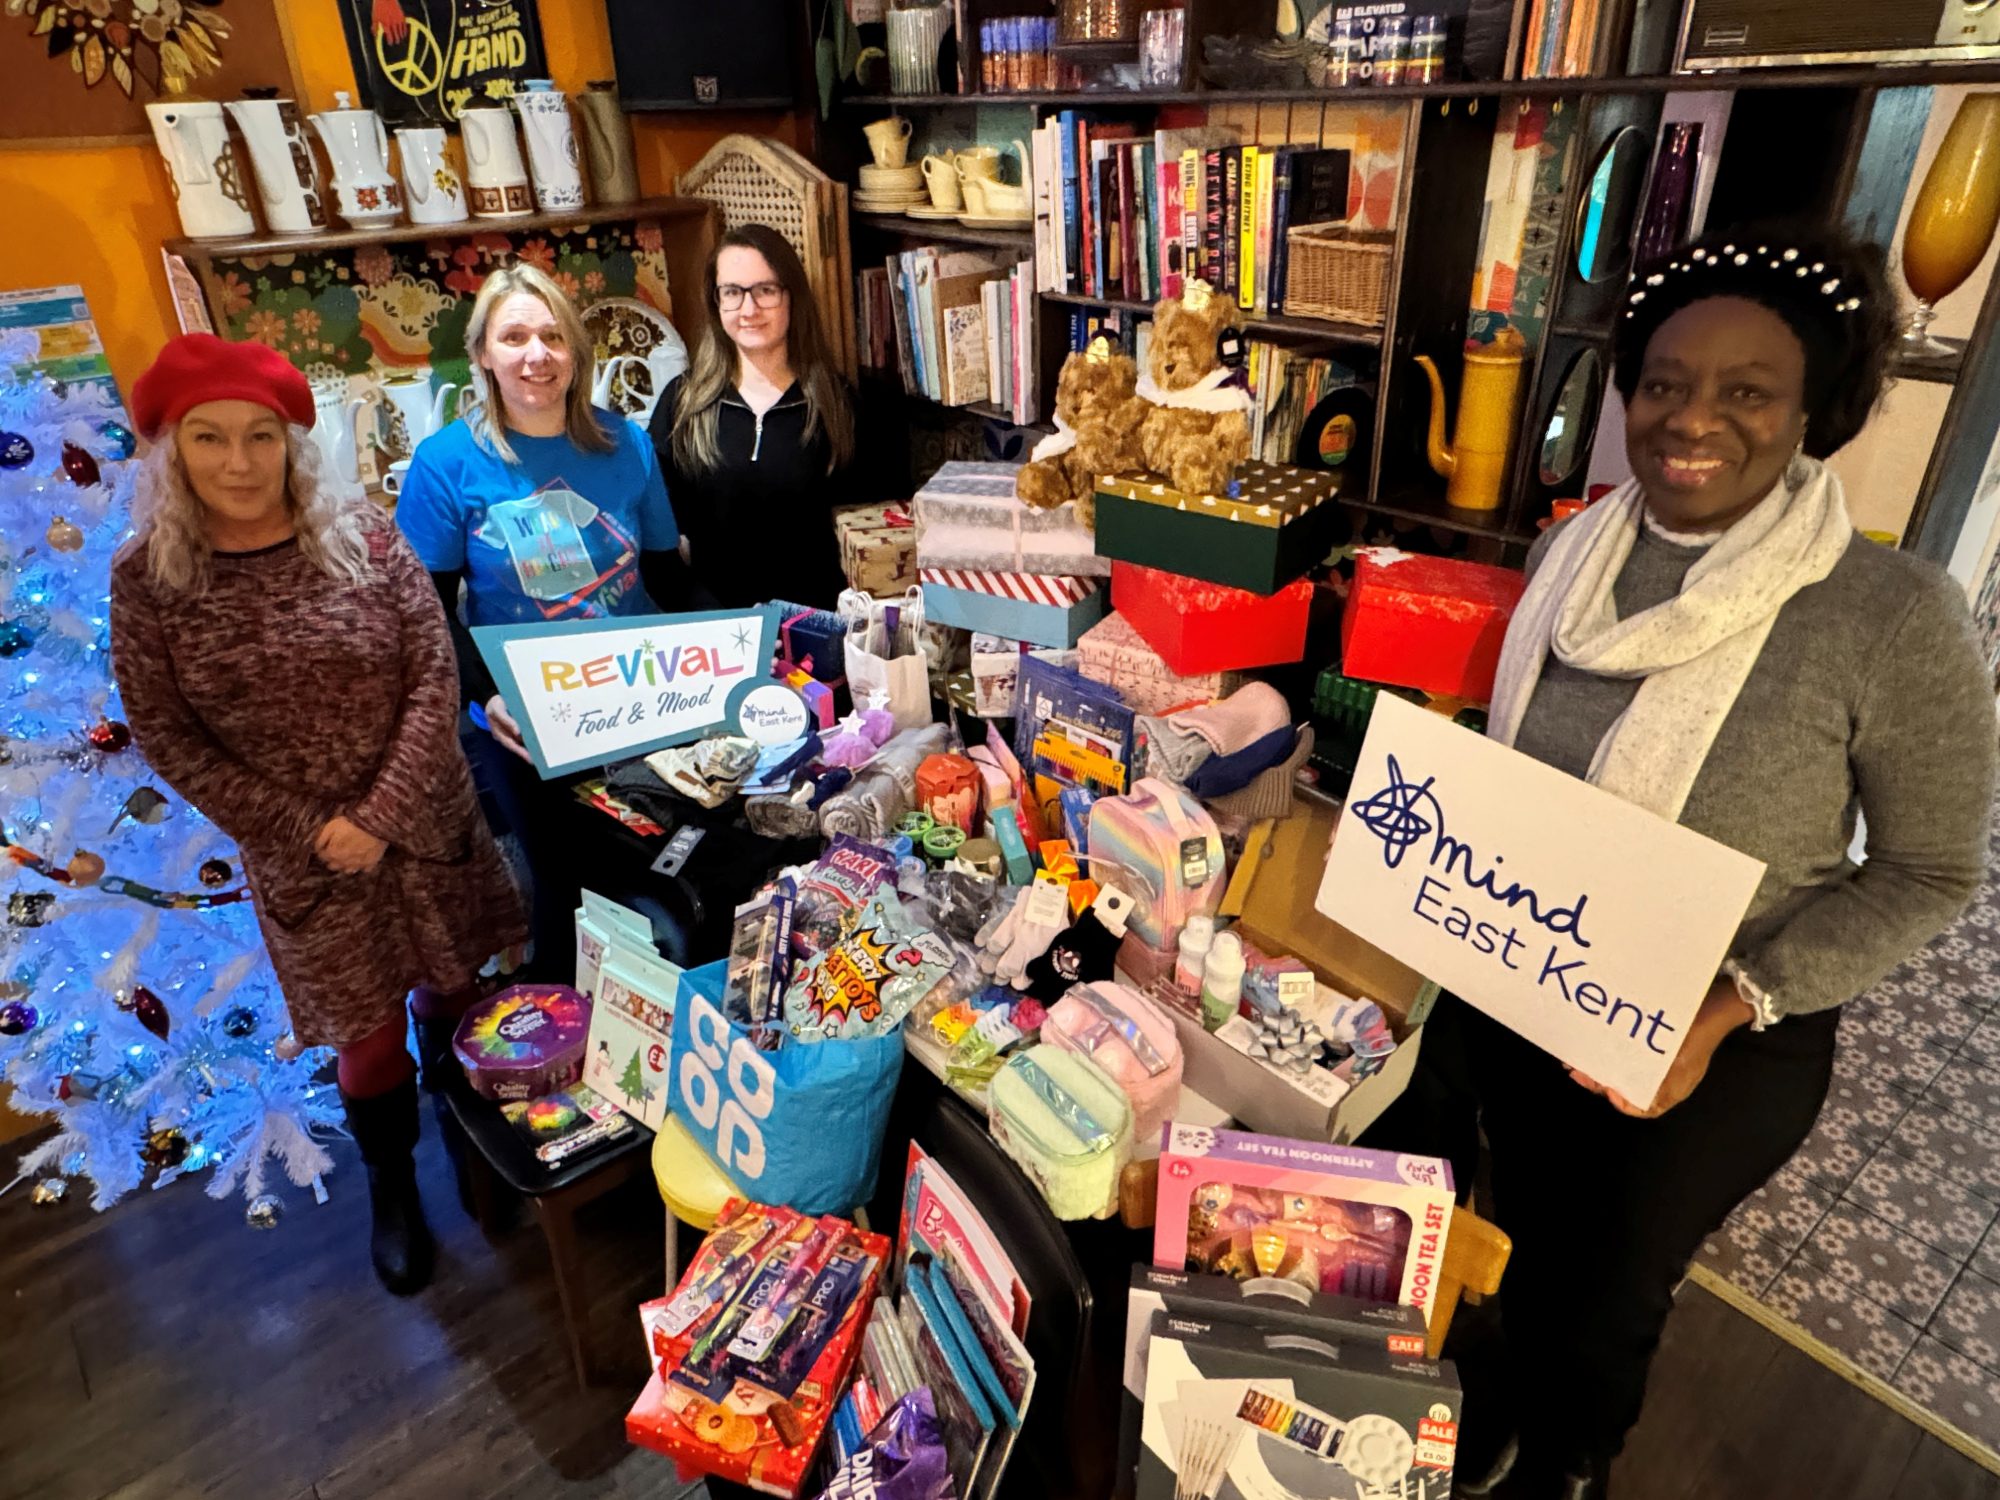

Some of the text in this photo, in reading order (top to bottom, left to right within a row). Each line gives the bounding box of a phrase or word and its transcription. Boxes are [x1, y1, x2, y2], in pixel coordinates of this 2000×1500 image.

[1354, 3, 1405, 17] ELEVATED
[1242, 156, 1253, 234] BEING BRITNEY
[575, 684, 715, 738] Food & Mood
[1429, 836, 1592, 948] mind
[1412, 875, 1676, 1055] East Kent
[1237, 1141, 1374, 1169] AFTERNOON TEA SET
[1424, 1203, 1445, 1230] SET
[1418, 1233, 1439, 1259] TEA
[1388, 1339, 1422, 1353] SALE
[1421, 1422, 1455, 1440] SALE
